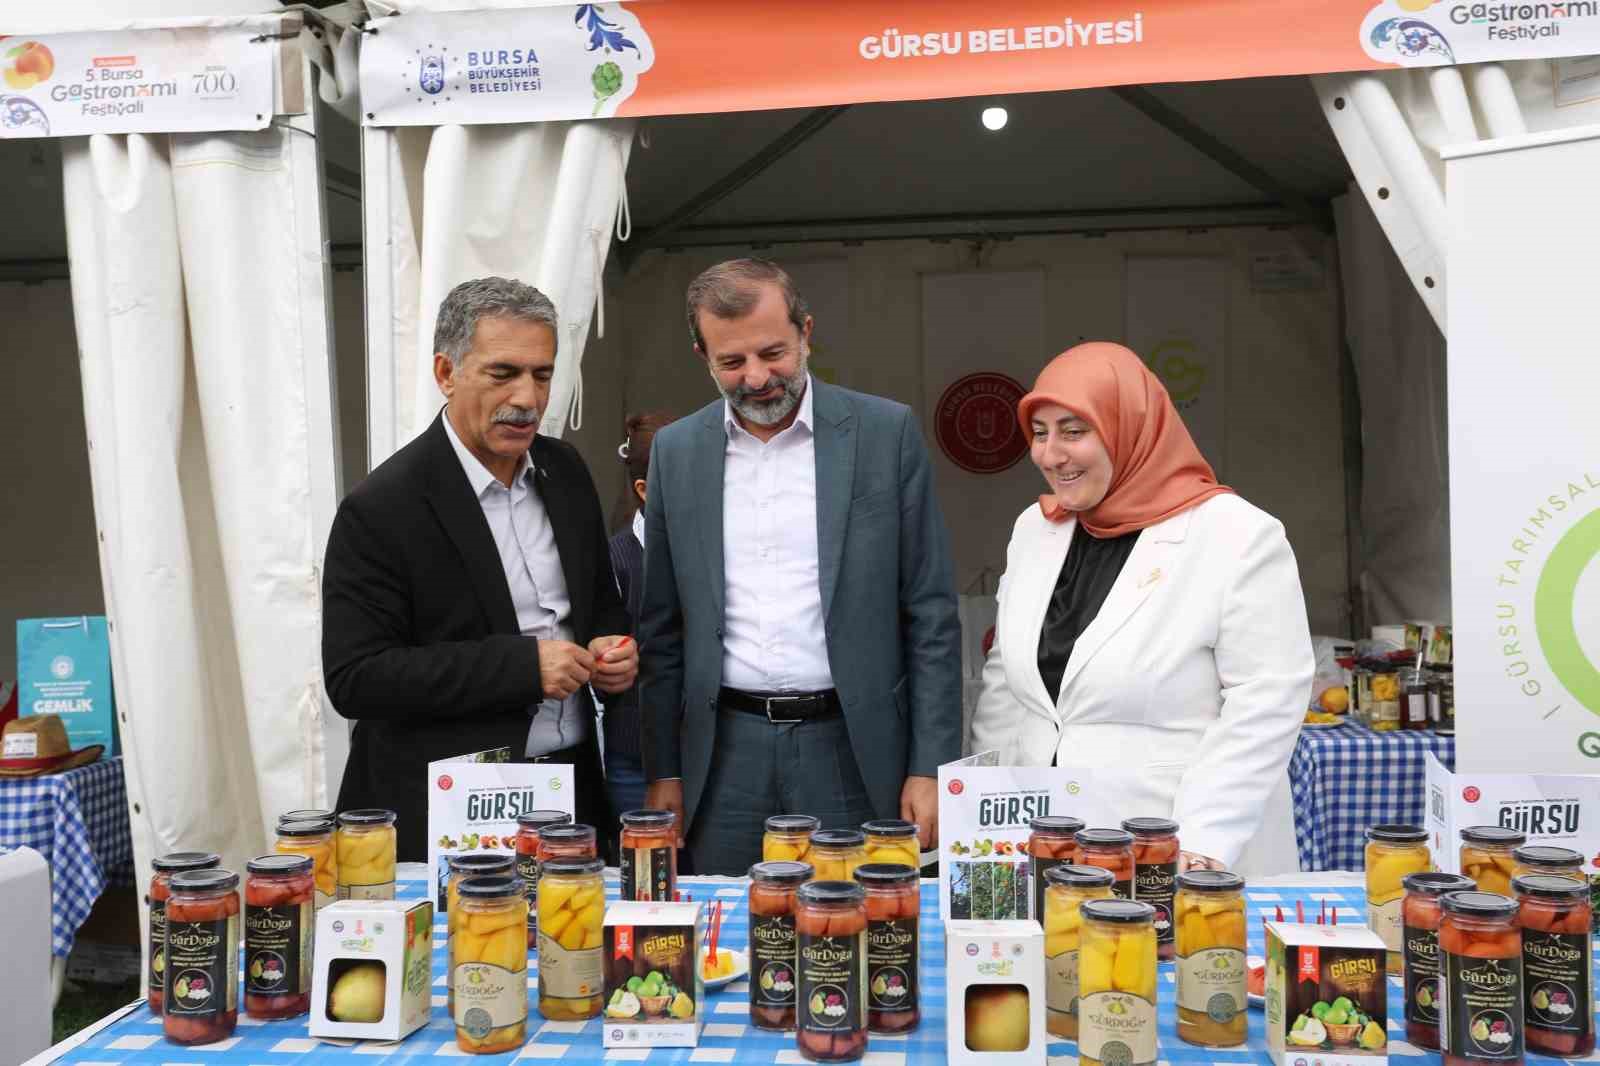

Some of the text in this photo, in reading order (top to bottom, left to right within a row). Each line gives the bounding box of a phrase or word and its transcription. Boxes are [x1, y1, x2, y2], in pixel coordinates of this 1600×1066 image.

[859, 12, 1143, 60] GÜRSU BELEDİYESİ
[1488, 22, 1560, 41] Festivali
[467, 48, 539, 66] BURSA
[101, 67, 143, 80] Bursa
[51, 81, 177, 102] Gastronomi
[469, 78, 542, 93] BELEDİYESİ
[81, 101, 144, 117] Festivali
[1496, 473, 1600, 697] GÜRSU TARIMSAL
[467, 791, 534, 821] GÜRSU
[979, 795, 1050, 826] GÜRSU
[1499, 803, 1580, 834] GÜRSU
[643, 934, 685, 954] GÜRSU
[1330, 957, 1377, 979] GÜRSU
